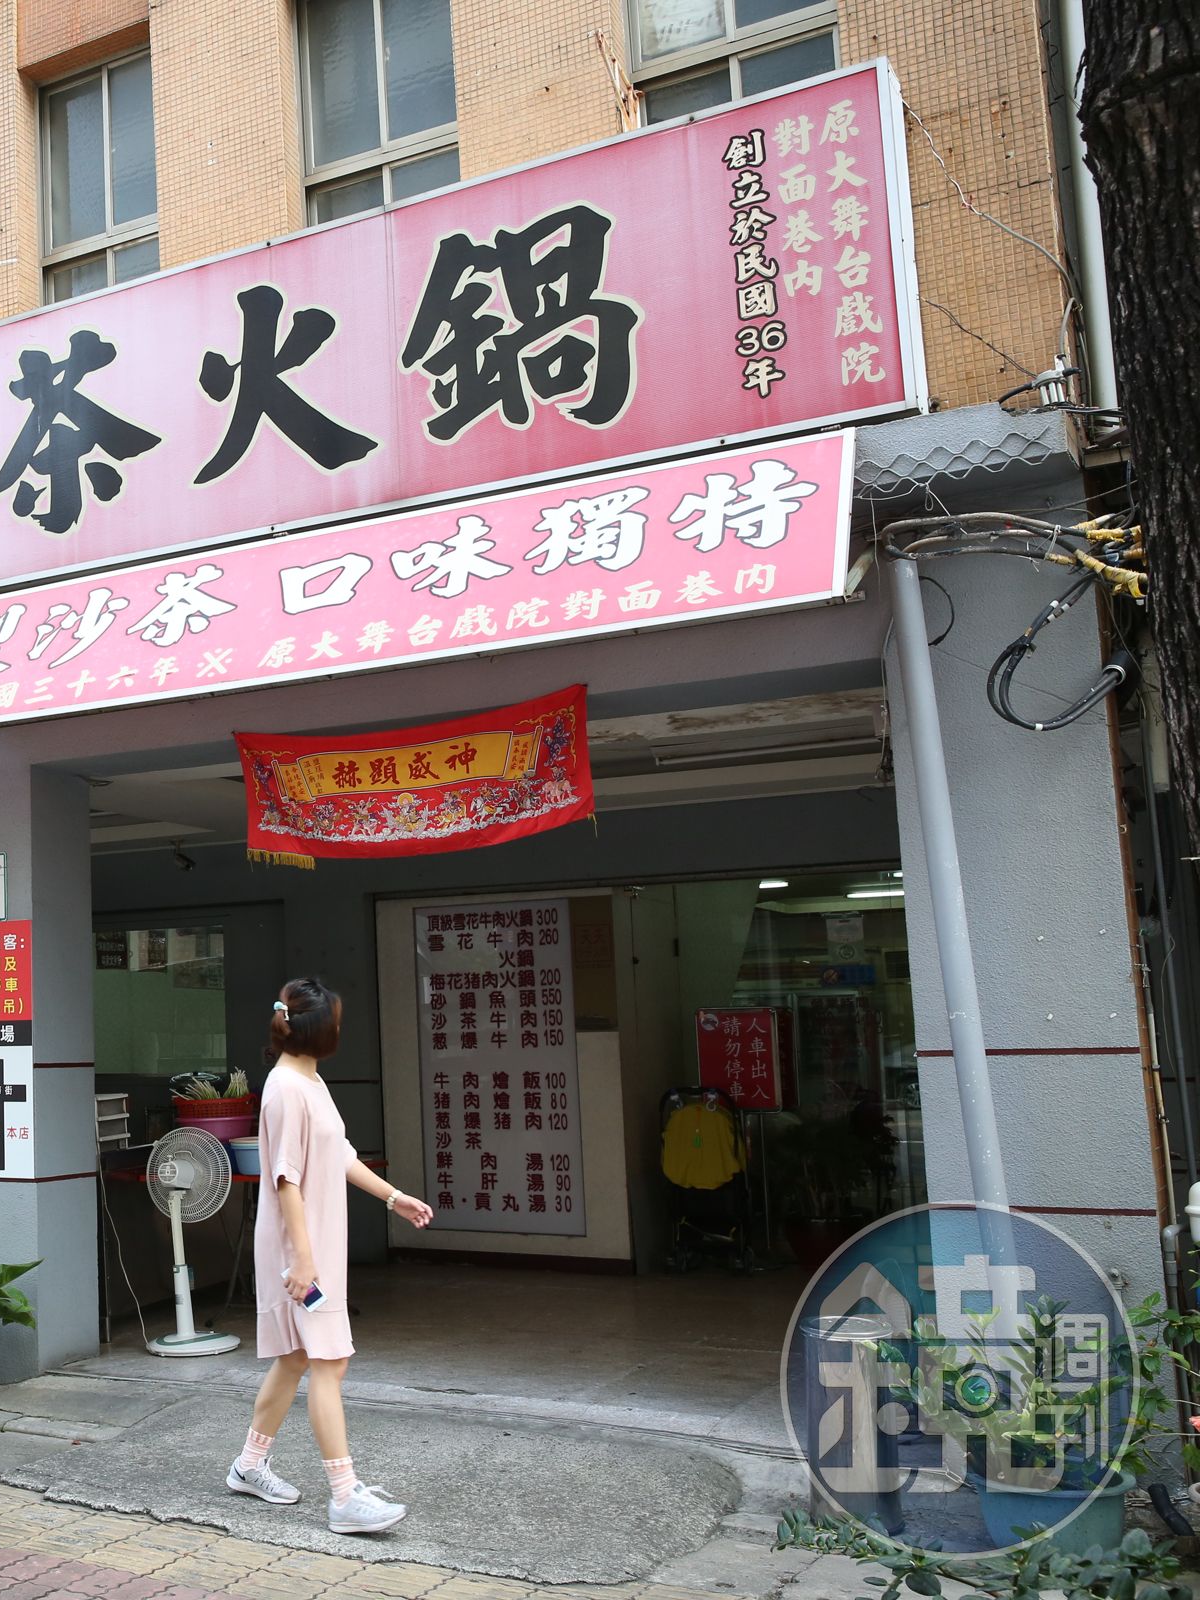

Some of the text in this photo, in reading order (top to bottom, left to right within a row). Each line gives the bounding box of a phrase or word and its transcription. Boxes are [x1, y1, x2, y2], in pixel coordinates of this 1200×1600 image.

[820, 99, 886, 387] 原大舞台戲院
[723, 129, 786, 398] 創立於民國36年
[536, 908, 558, 926] 300
[539, 929, 559, 946] 260
[540, 968, 561, 985] 200
[541, 988, 562, 1005] 550
[543, 1009, 563, 1026] 150
[544, 1029, 564, 1046] 150
[545, 1072, 566, 1089] 100
[550, 1092, 567, 1110] 80
[548, 1112, 568, 1131] 120
[6, 1126, 30, 1140] 本店
[550, 1154, 570, 1171] 120
[556, 1175, 571, 1191] 90
[555, 1196, 572, 1213] 30
